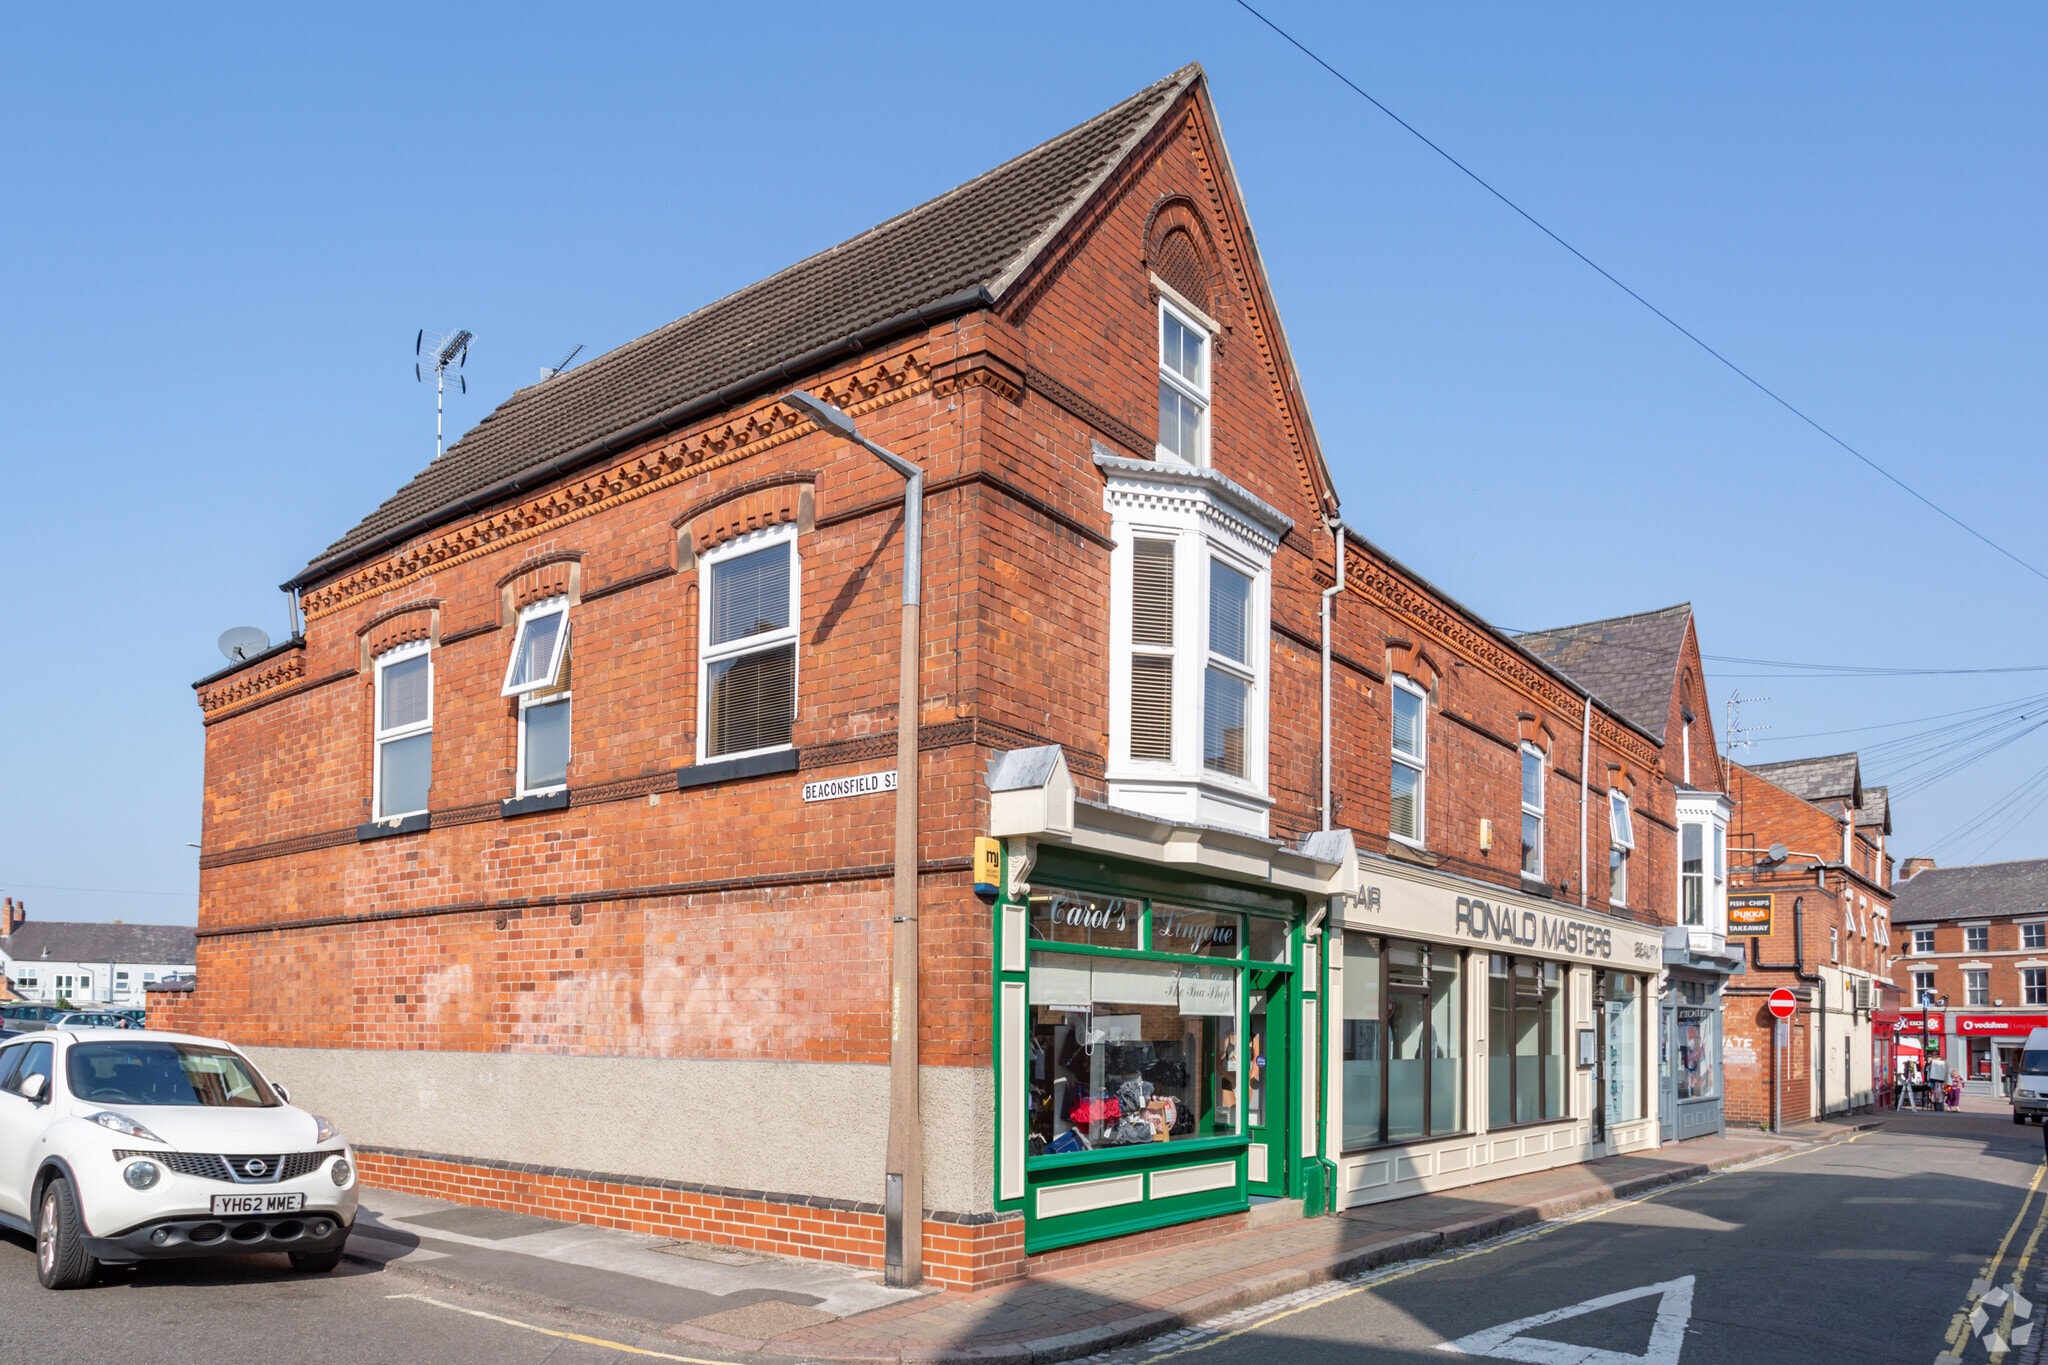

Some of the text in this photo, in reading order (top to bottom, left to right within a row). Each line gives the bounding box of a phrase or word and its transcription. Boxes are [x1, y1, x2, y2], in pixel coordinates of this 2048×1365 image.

[805, 775, 878, 799] BEACONSFIELD
[1049, 889, 1233, 954] Carol's Lingerie
[1733, 910, 1765, 918] PUKKA
[1456, 896, 1612, 958] RONALD MASTERS
[1974, 1021, 2009, 1029] vodafone
[222, 1196, 296, 1212] YH62 MME
